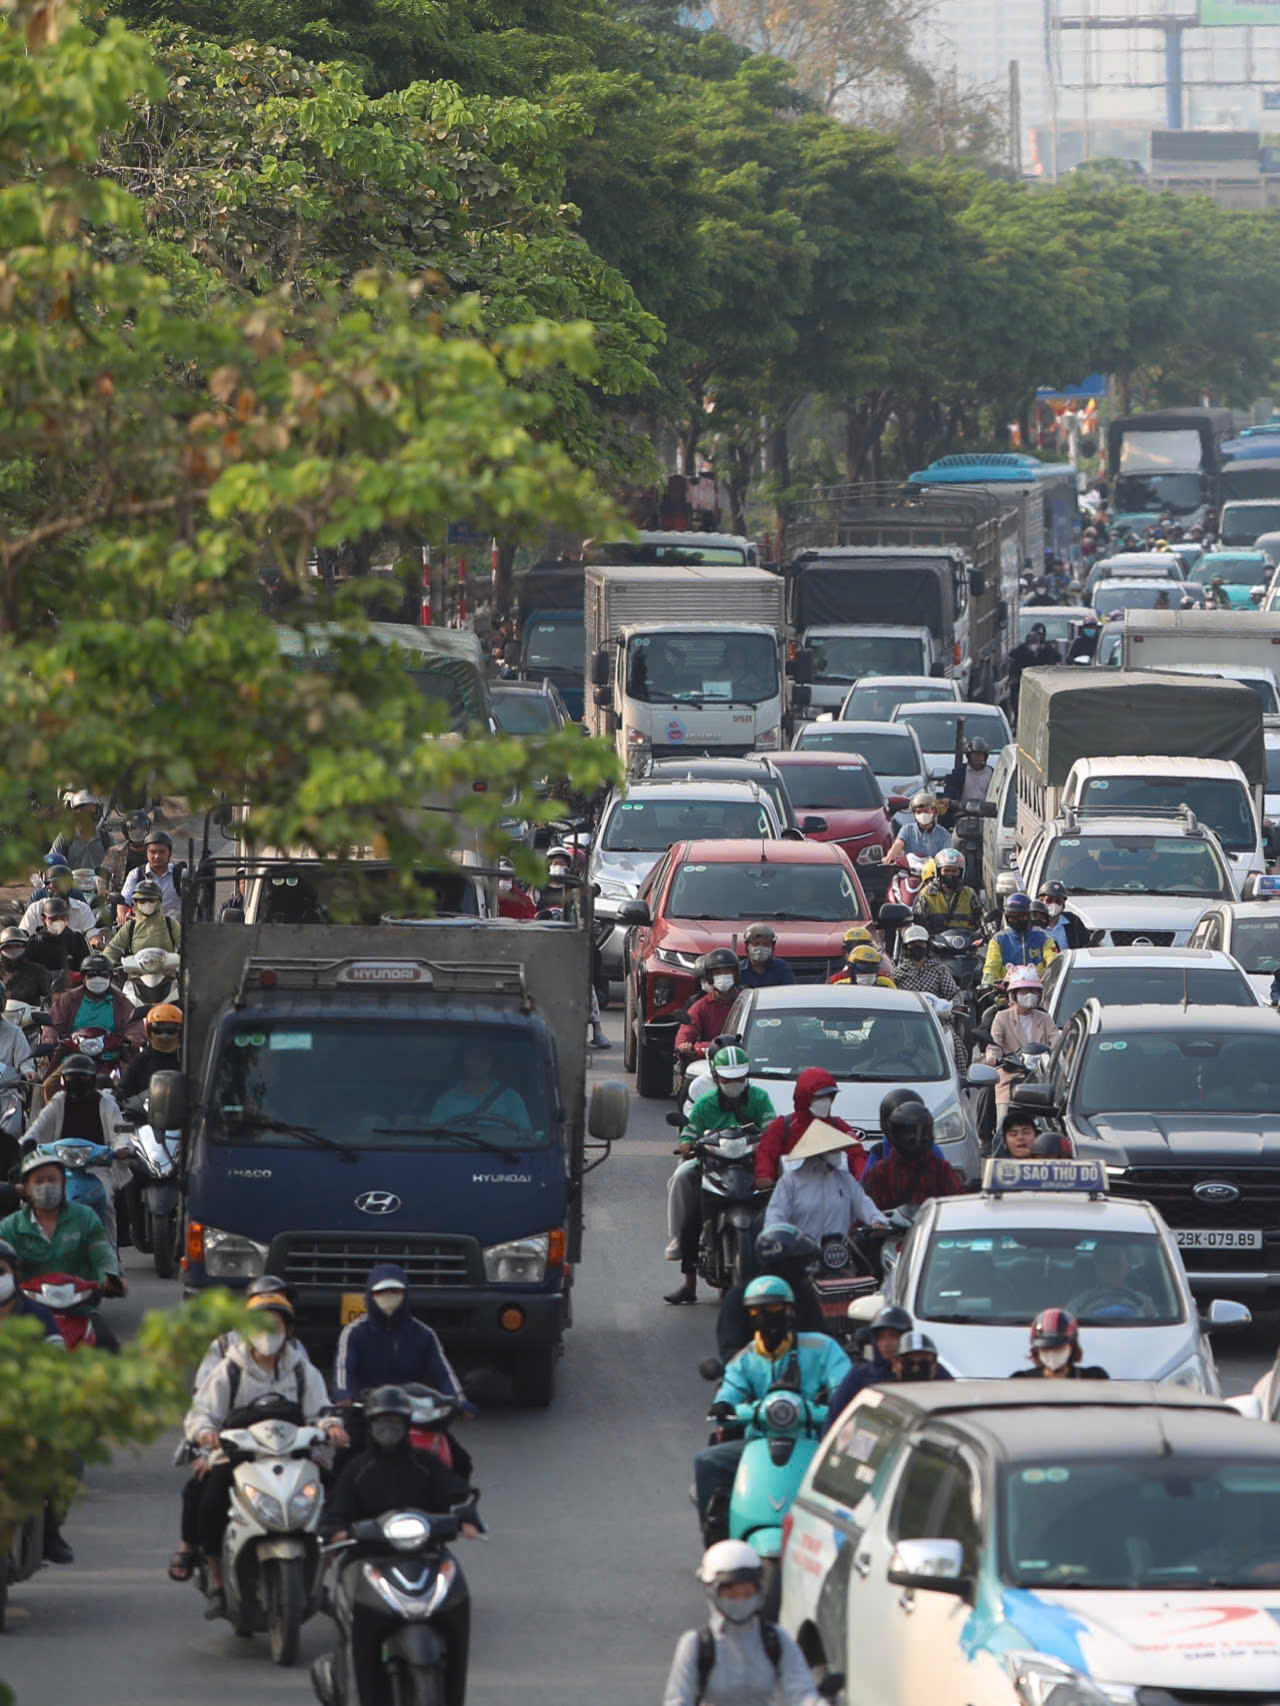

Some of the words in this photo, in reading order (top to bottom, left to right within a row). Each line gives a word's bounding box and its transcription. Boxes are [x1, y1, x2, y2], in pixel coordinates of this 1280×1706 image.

[353, 969, 414, 980] HYUNDAI
[473, 1173, 531, 1183] HYUNDAI
[1023, 1166, 1048, 1180] SAO
[1177, 1232, 1255, 1246] 29K-079.89
